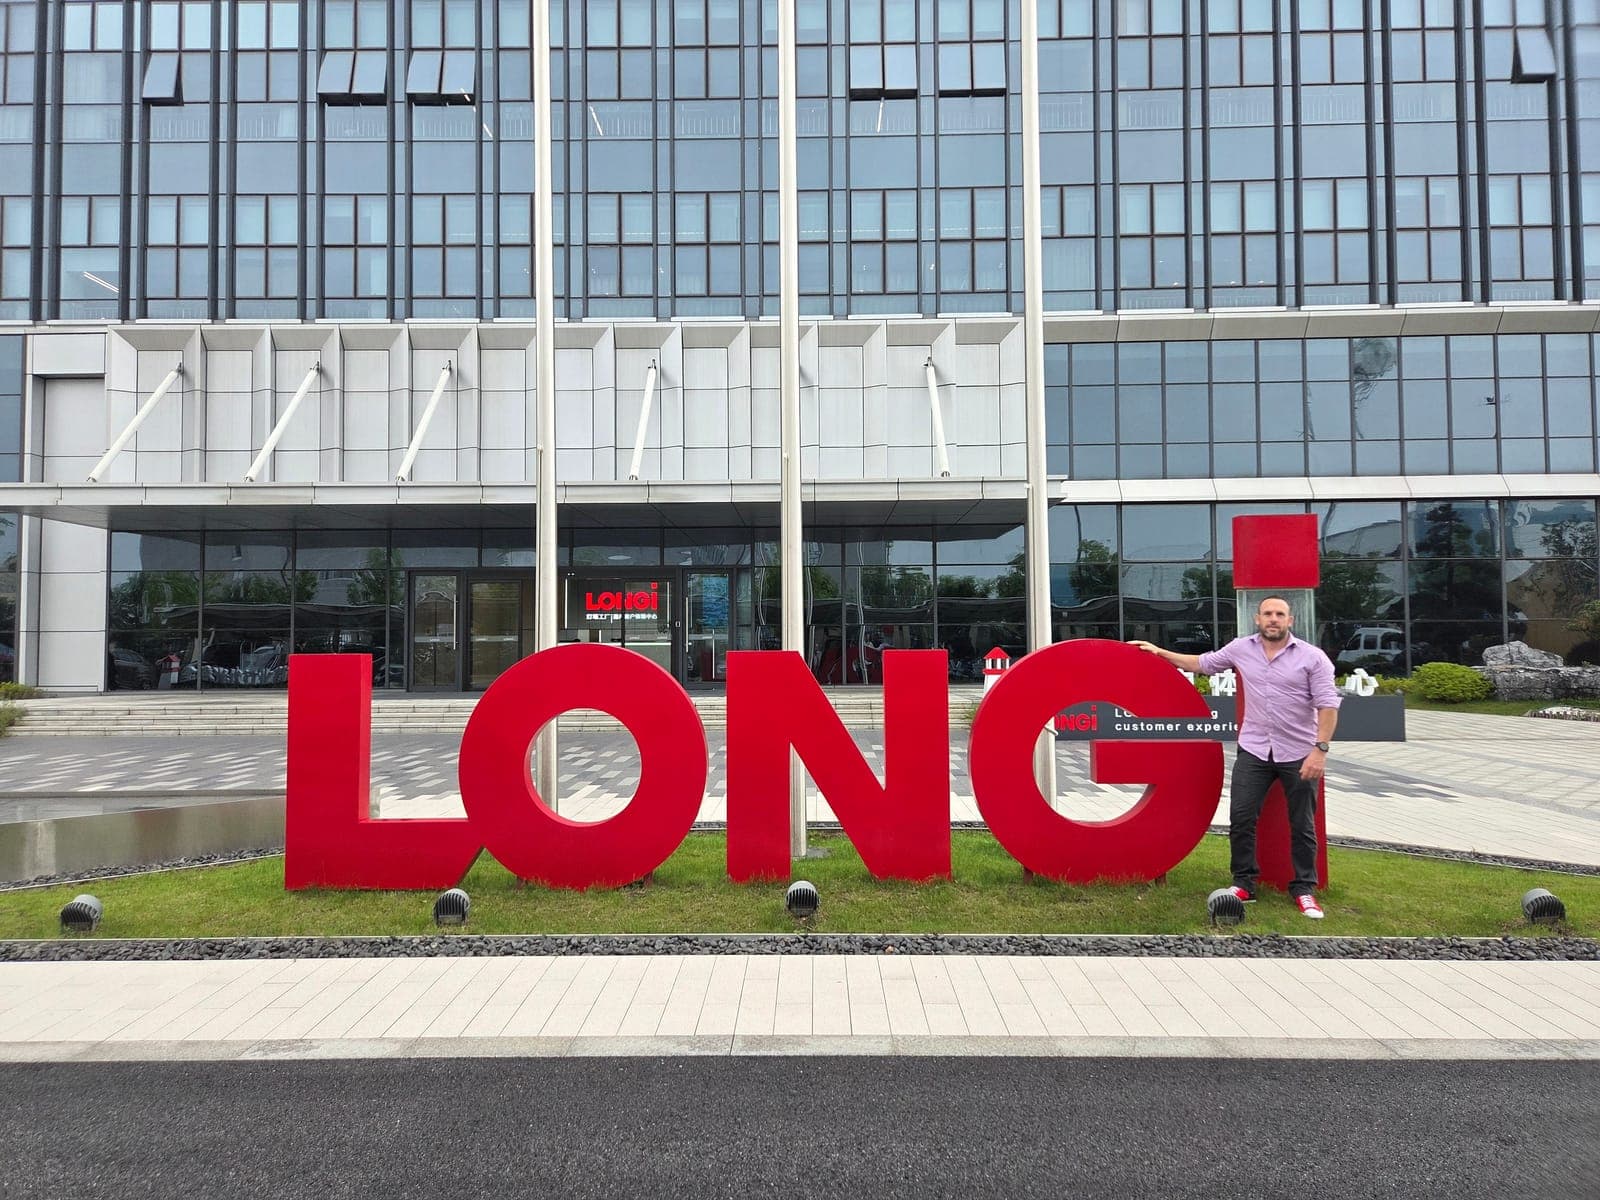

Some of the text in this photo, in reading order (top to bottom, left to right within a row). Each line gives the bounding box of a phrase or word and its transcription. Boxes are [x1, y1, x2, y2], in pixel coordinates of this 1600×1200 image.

[585, 582, 658, 610] LONGi
[1055, 704, 1098, 731] NGi
[1114, 721, 1181, 732] customer
